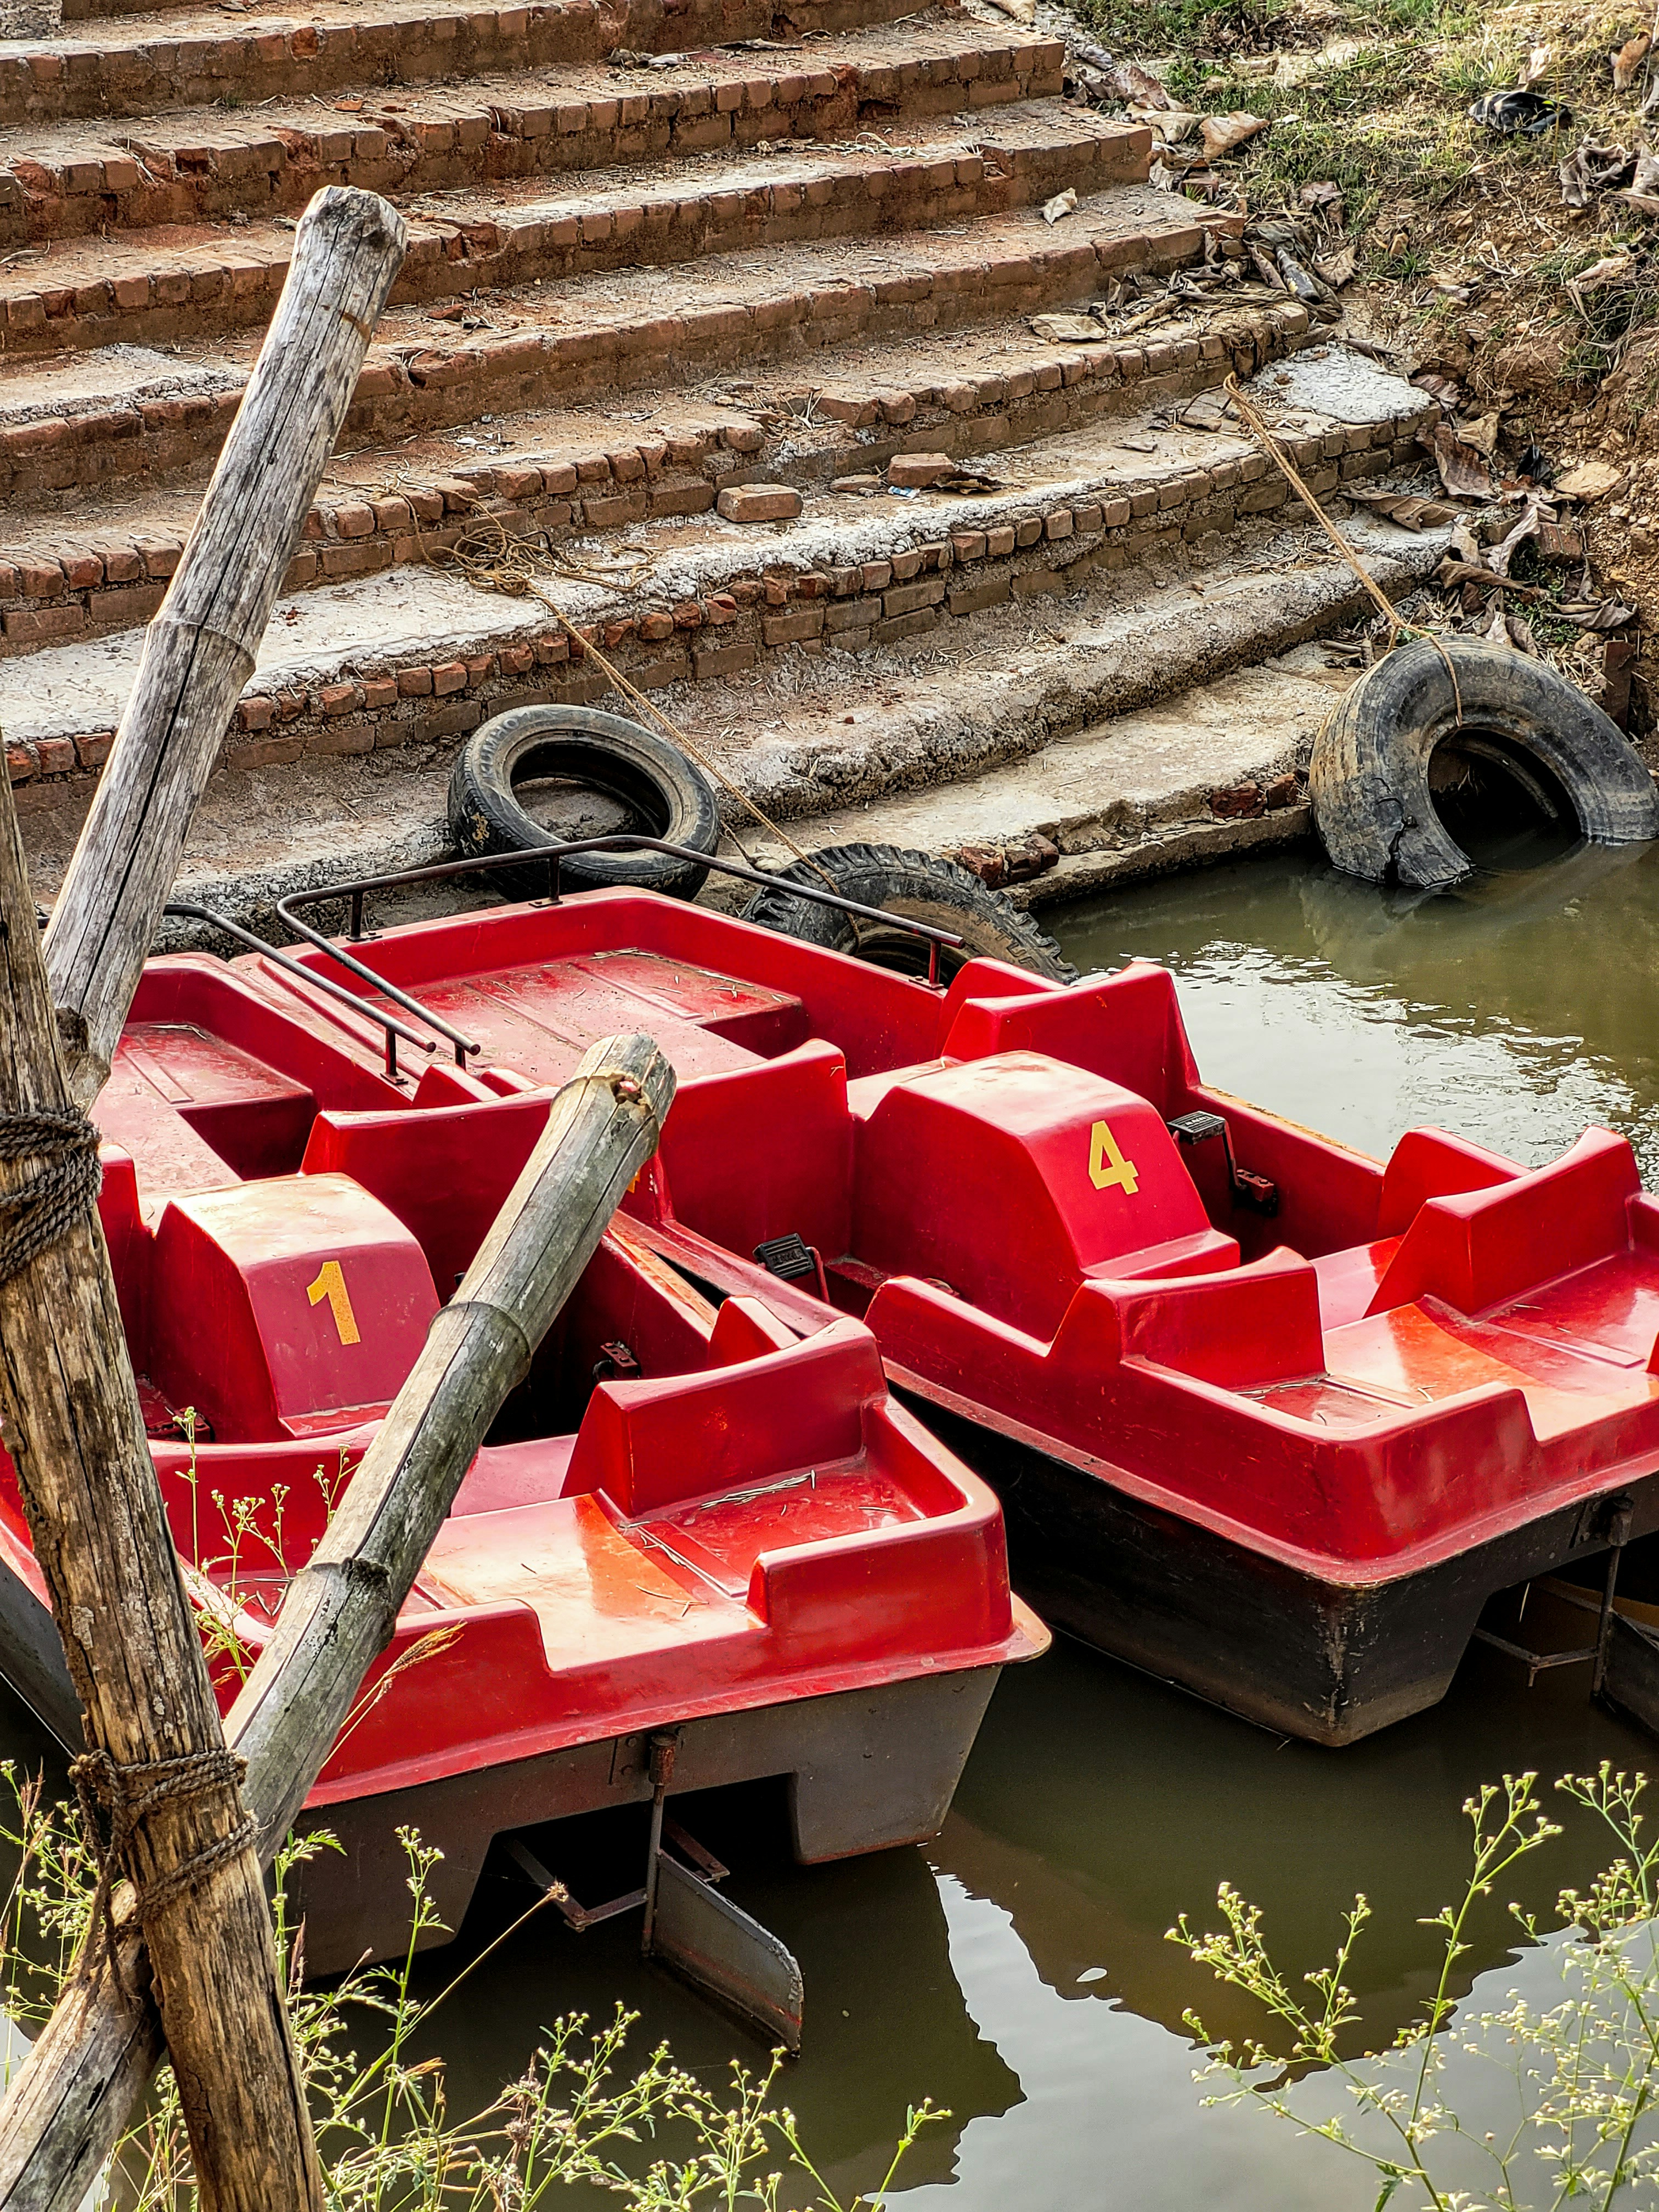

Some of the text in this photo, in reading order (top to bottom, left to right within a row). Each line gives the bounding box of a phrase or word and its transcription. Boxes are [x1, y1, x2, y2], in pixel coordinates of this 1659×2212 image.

[480, 718, 520, 778] KUMHO
[995, 928, 1041, 969] TUF
[1088, 1120, 1139, 1195] 4
[307, 1260, 361, 1345] 1
